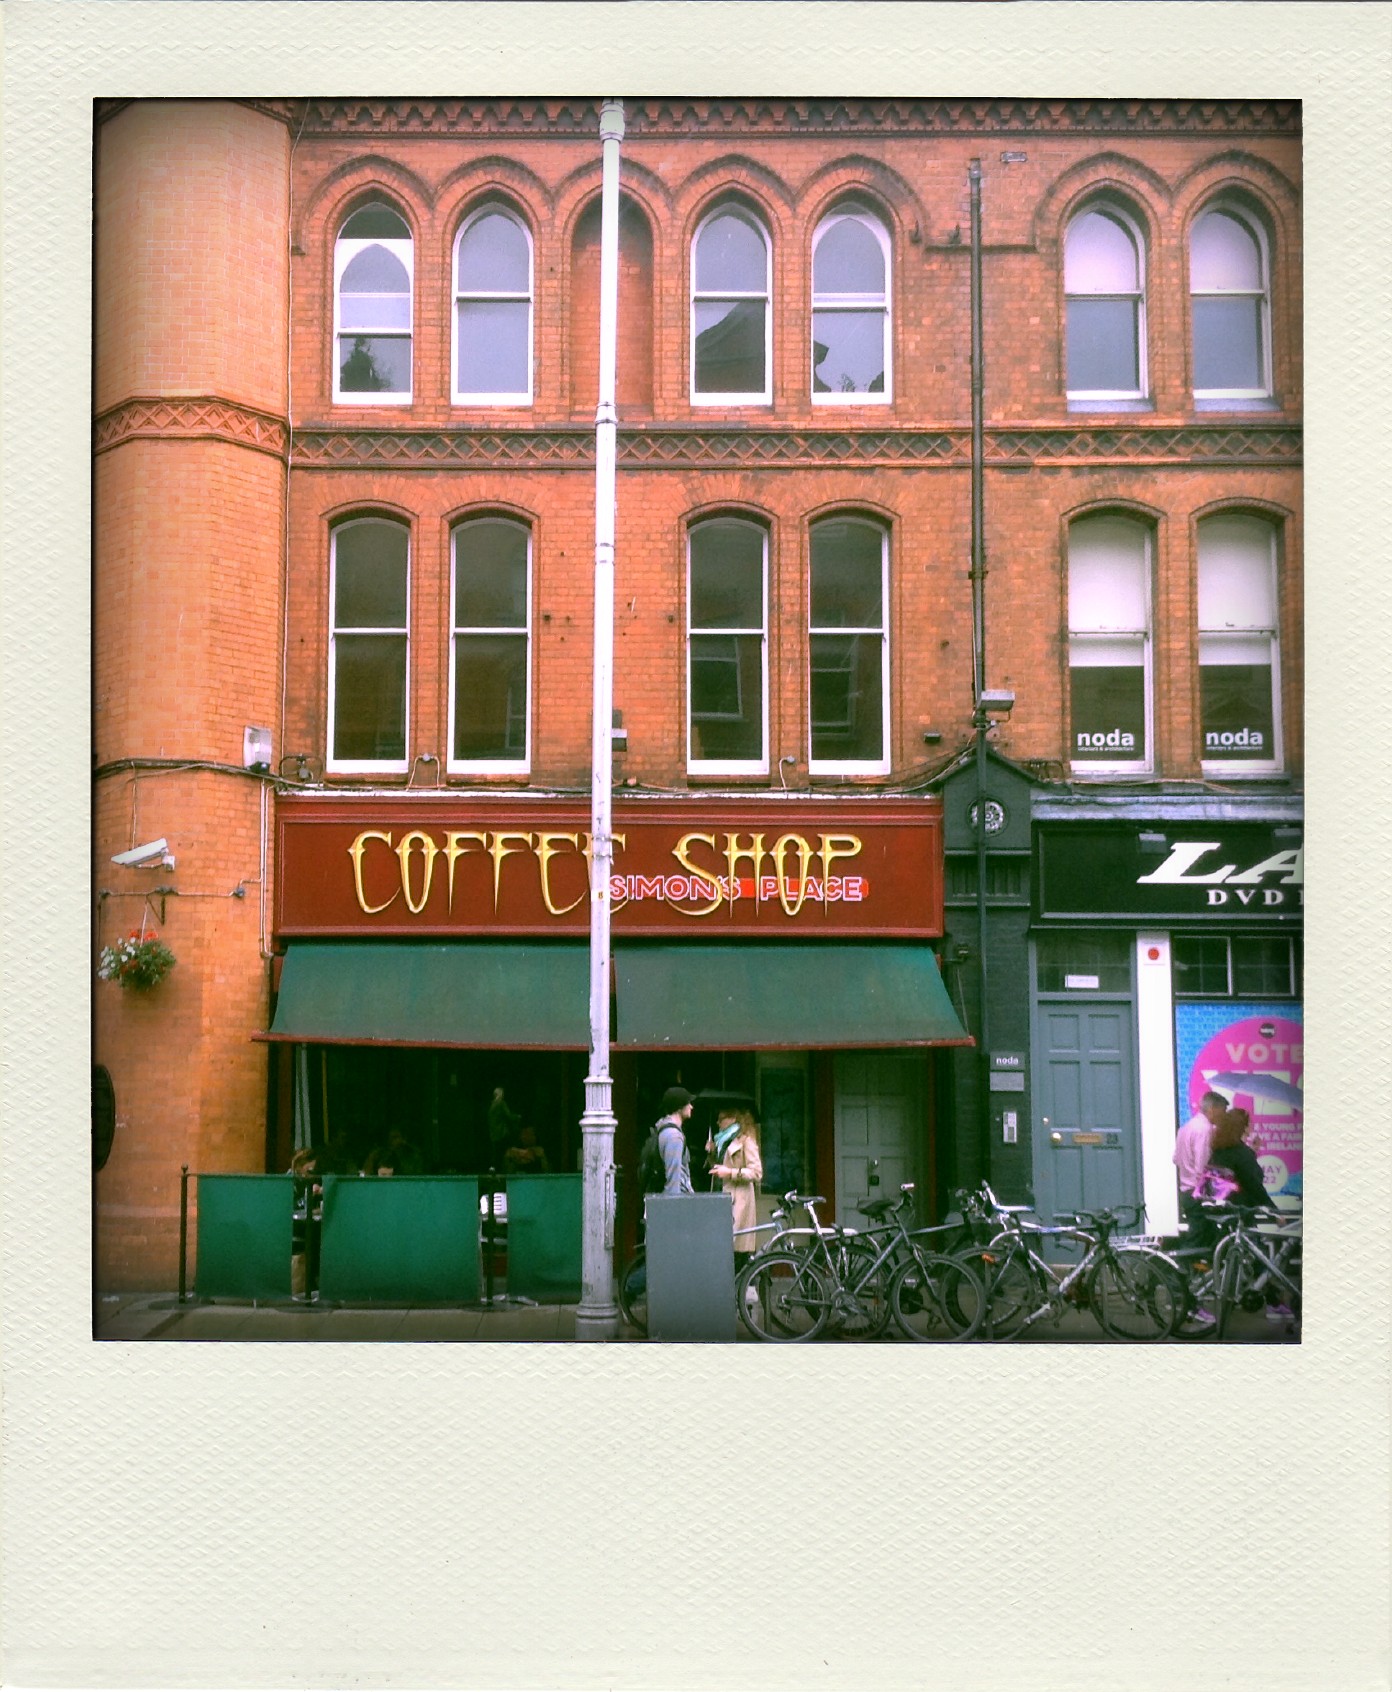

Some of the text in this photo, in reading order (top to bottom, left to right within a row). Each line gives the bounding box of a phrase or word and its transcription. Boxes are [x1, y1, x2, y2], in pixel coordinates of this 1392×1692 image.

[1077, 728, 1134, 746] noda
[1206, 727, 1263, 745] noda
[347, 830, 862, 918] COFFEE SHOP
[760, 876, 862, 901] PLACE
[1206, 889, 1285, 906] DVD
[996, 1056, 1019, 1066] noda
[1225, 1043, 1303, 1064] VOTE
